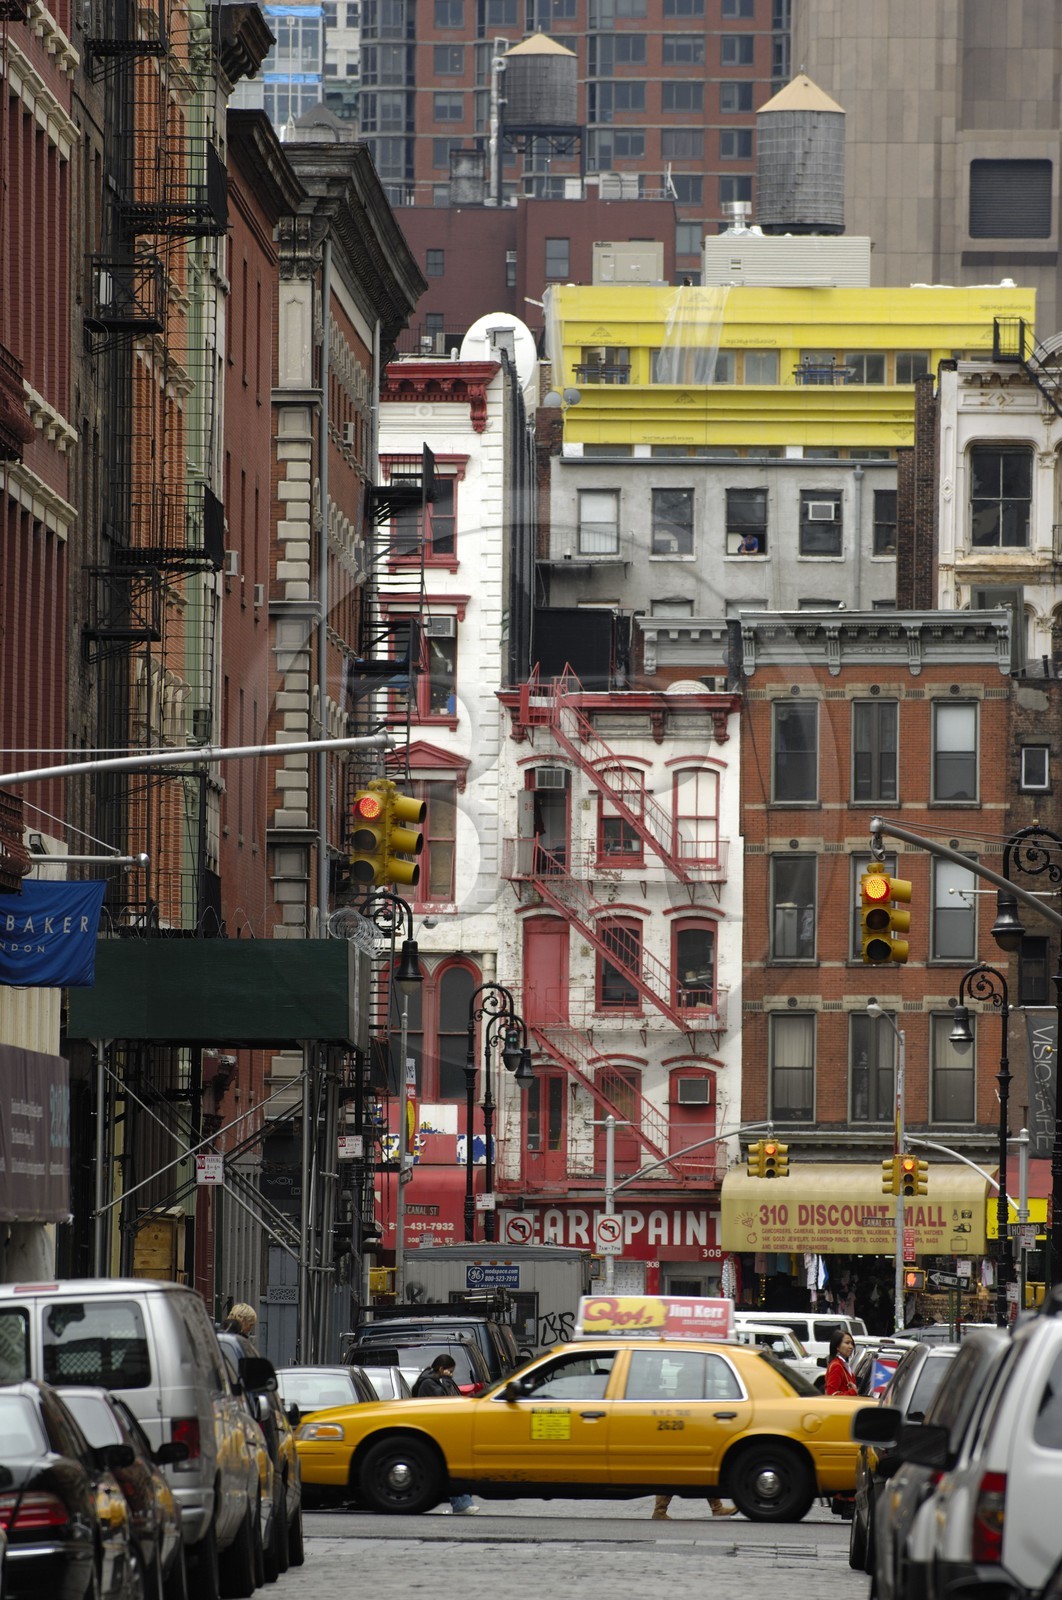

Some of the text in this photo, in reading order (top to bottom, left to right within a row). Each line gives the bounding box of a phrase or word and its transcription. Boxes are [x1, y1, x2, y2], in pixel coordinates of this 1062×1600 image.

[6, 914, 89, 934] BAKER
[1032, 1025, 1056, 1150] VISIOAIRE
[407, 1205, 437, 1216] CANAL ST
[759, 1204, 789, 1226] 310
[798, 1204, 889, 1227] DISCOUNT
[388, 1222, 455, 1231] 2-431-7932
[622, 1209, 722, 1246] PAINT
[862, 1218, 894, 1227] CANAL ST
[1011, 1224, 1040, 1236] HOD
[702, 1249, 722, 1258] 308
[951, 1278, 965, 1287] WY
[669, 1304, 724, 1318] Jim Kerr
